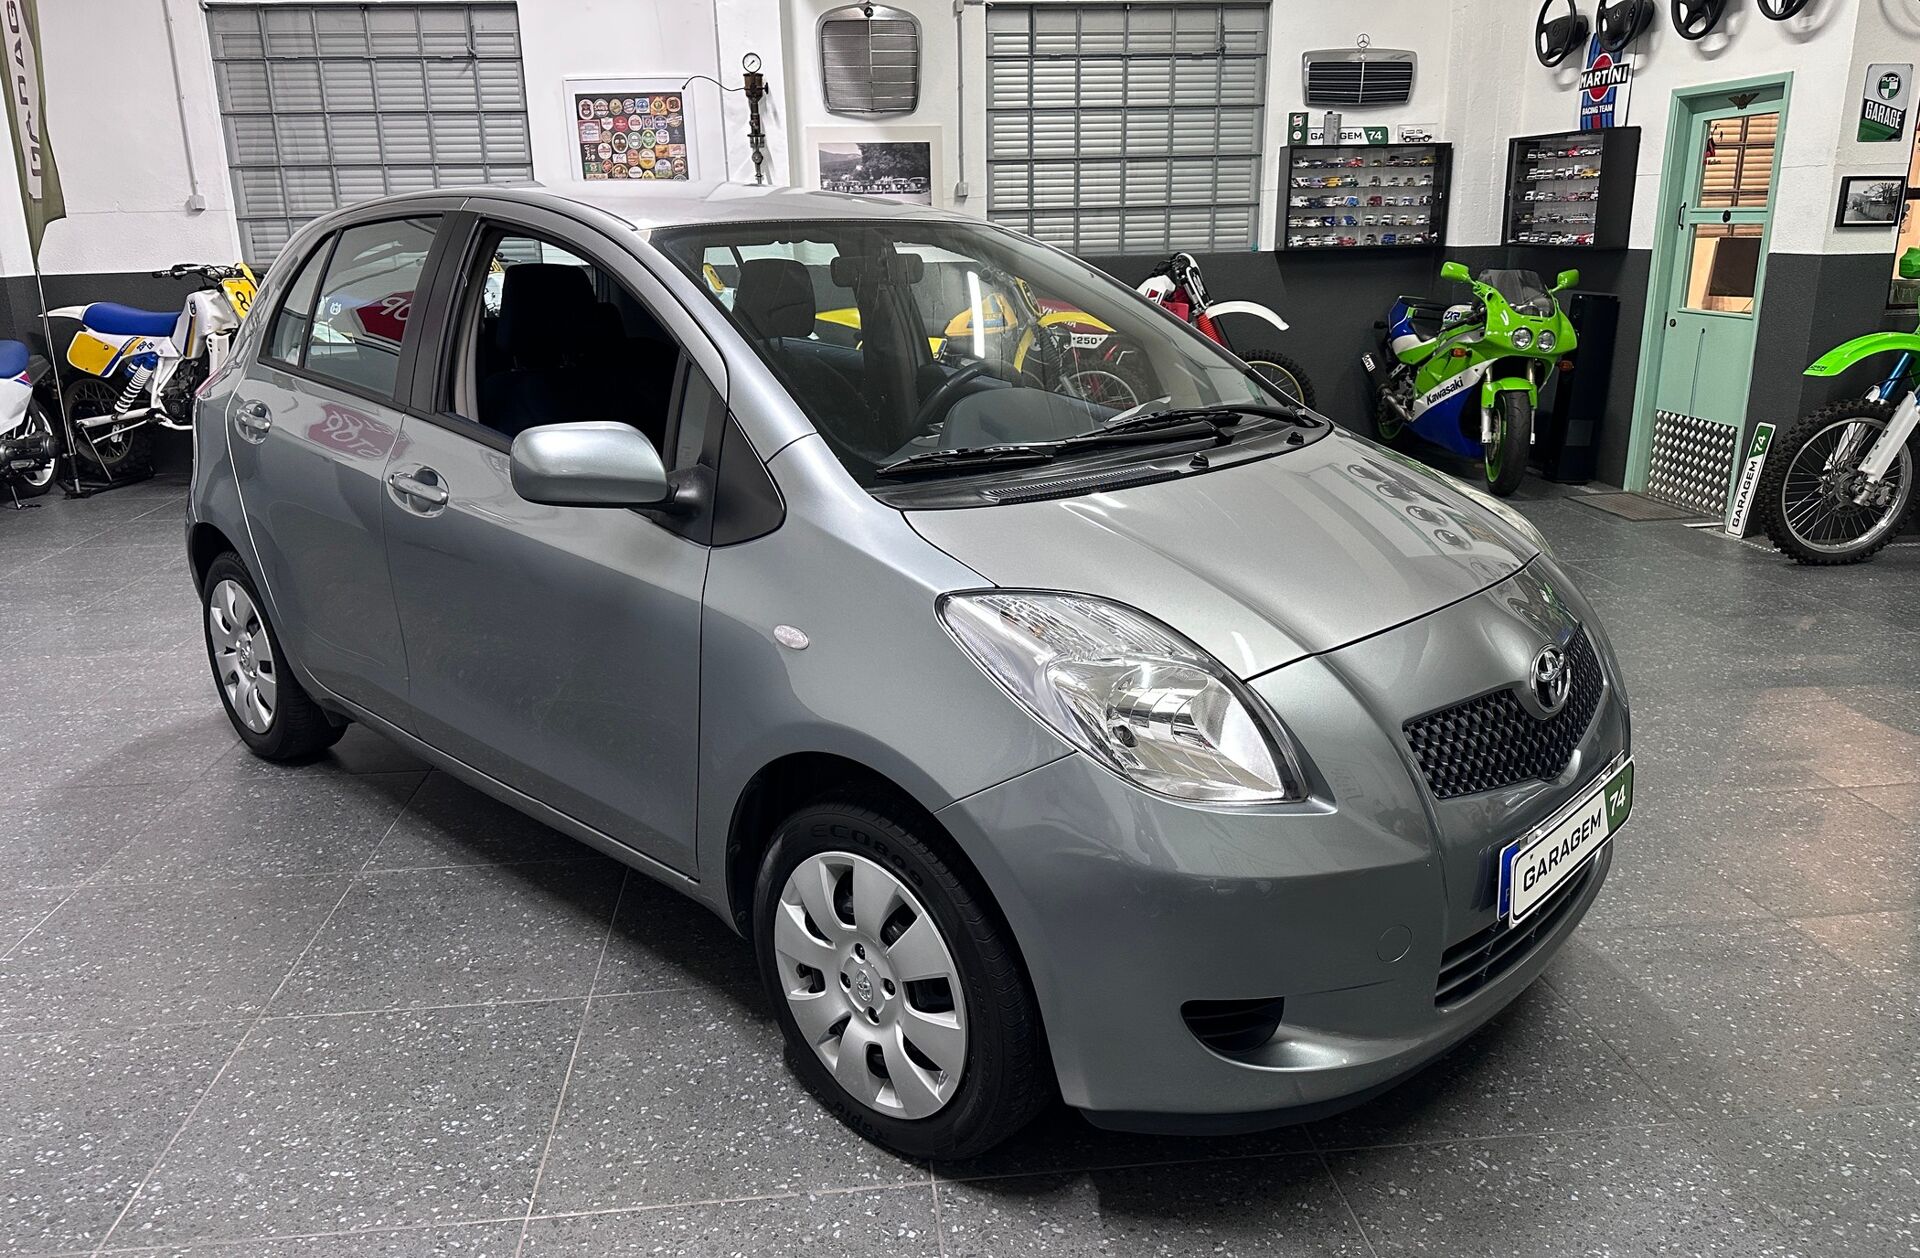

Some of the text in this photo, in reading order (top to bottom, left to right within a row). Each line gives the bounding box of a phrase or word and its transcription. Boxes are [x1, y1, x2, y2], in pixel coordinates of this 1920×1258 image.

[1580, 66, 1629, 88] MARTINI
[1582, 104, 1613, 115] RACING TEAM
[1865, 101, 1902, 129] GARAGE
[1310, 131, 1383, 140] GAGEM 74
[1076, 336, 1098, 345] 250
[1426, 376, 1464, 405] Kawasaki
[1732, 434, 1766, 527] GARAGEM 74
[1523, 784, 1626, 892] GARAGEM 74
